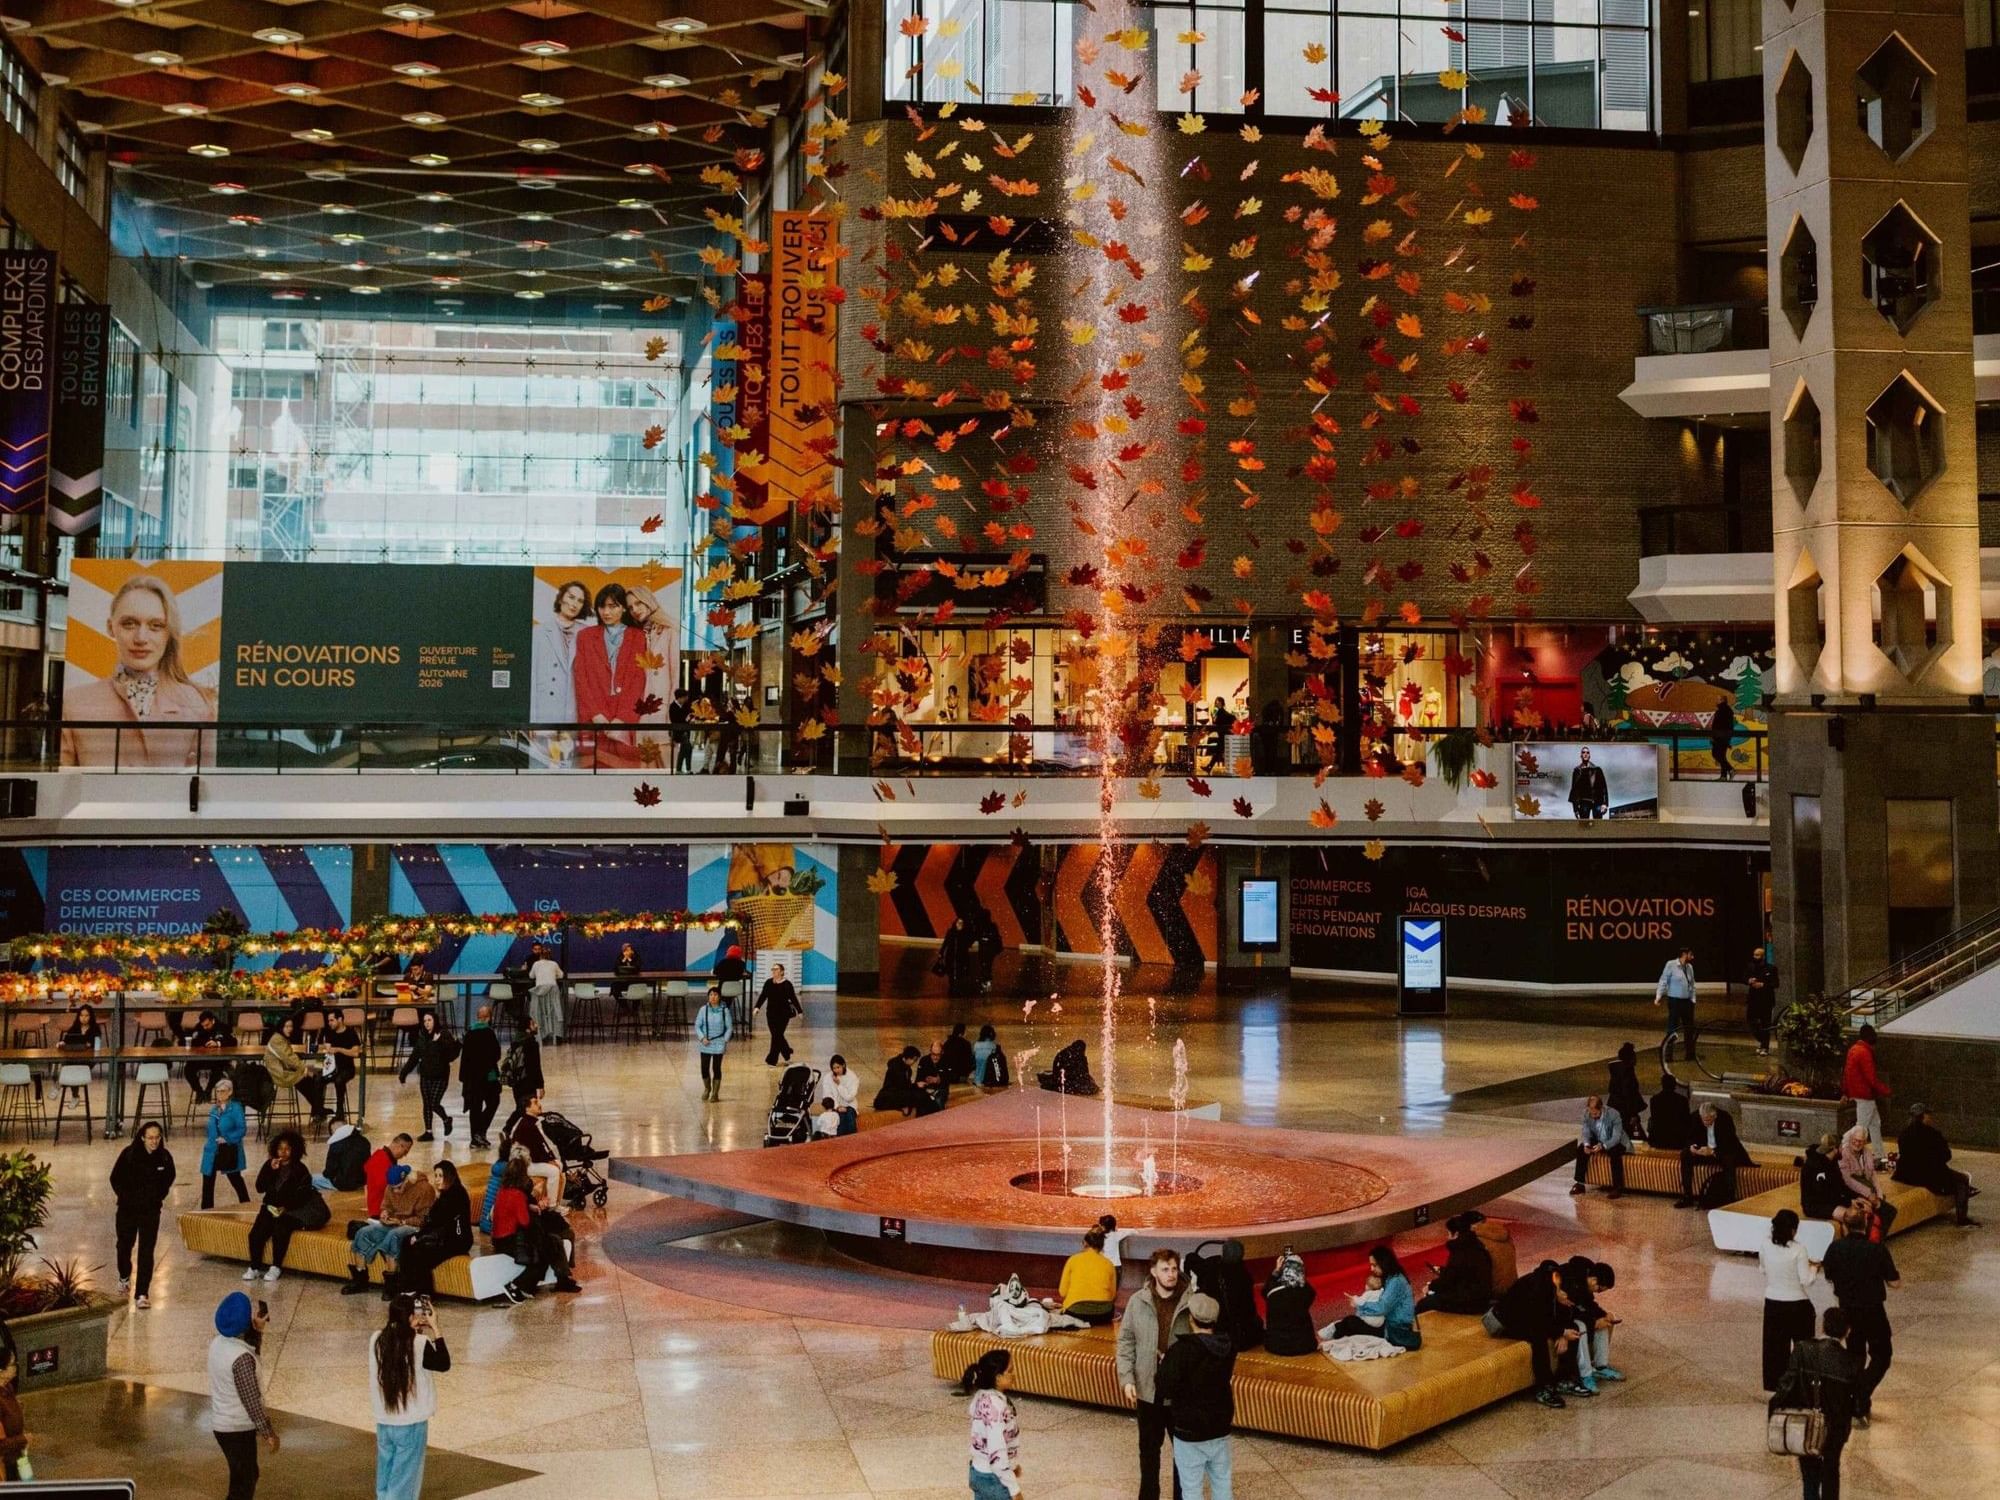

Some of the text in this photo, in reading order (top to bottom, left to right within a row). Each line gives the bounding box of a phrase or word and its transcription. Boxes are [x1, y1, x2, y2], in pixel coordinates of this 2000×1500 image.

[780, 219, 802, 408] TOUT TROUVER
[1, 257, 26, 390] COMPLEXE
[23, 257, 48, 390] DESJARDINS
[60, 311, 82, 405] TOUS LES
[81, 312, 101, 406] SERVICES
[236, 640, 400, 664] RÉNOVATIONS
[419, 646, 479, 656] OUVERTURE
[419, 654, 457, 665] PRÉVUE
[236, 668, 356, 687] EN COURS
[418, 669, 469, 679] AUTOMNE
[418, 678, 444, 688] 2026
[1291, 878, 1371, 894] COMMERCES
[1405, 886, 1428, 898] IGA
[60, 889, 201, 902] CES COMMERCES
[1291, 893, 1340, 907] EURENT
[60, 906, 159, 919] DEMEURENT
[534, 899, 561, 912] IGA
[1405, 901, 1527, 920] JACQUES DESPARS
[1566, 894, 1715, 917] RÉNOVATIONS
[1291, 908, 1382, 925] ERTS PENDANT
[59, 922, 133, 936] OUVERTS
[1567, 922, 1673, 941] EN COURS
